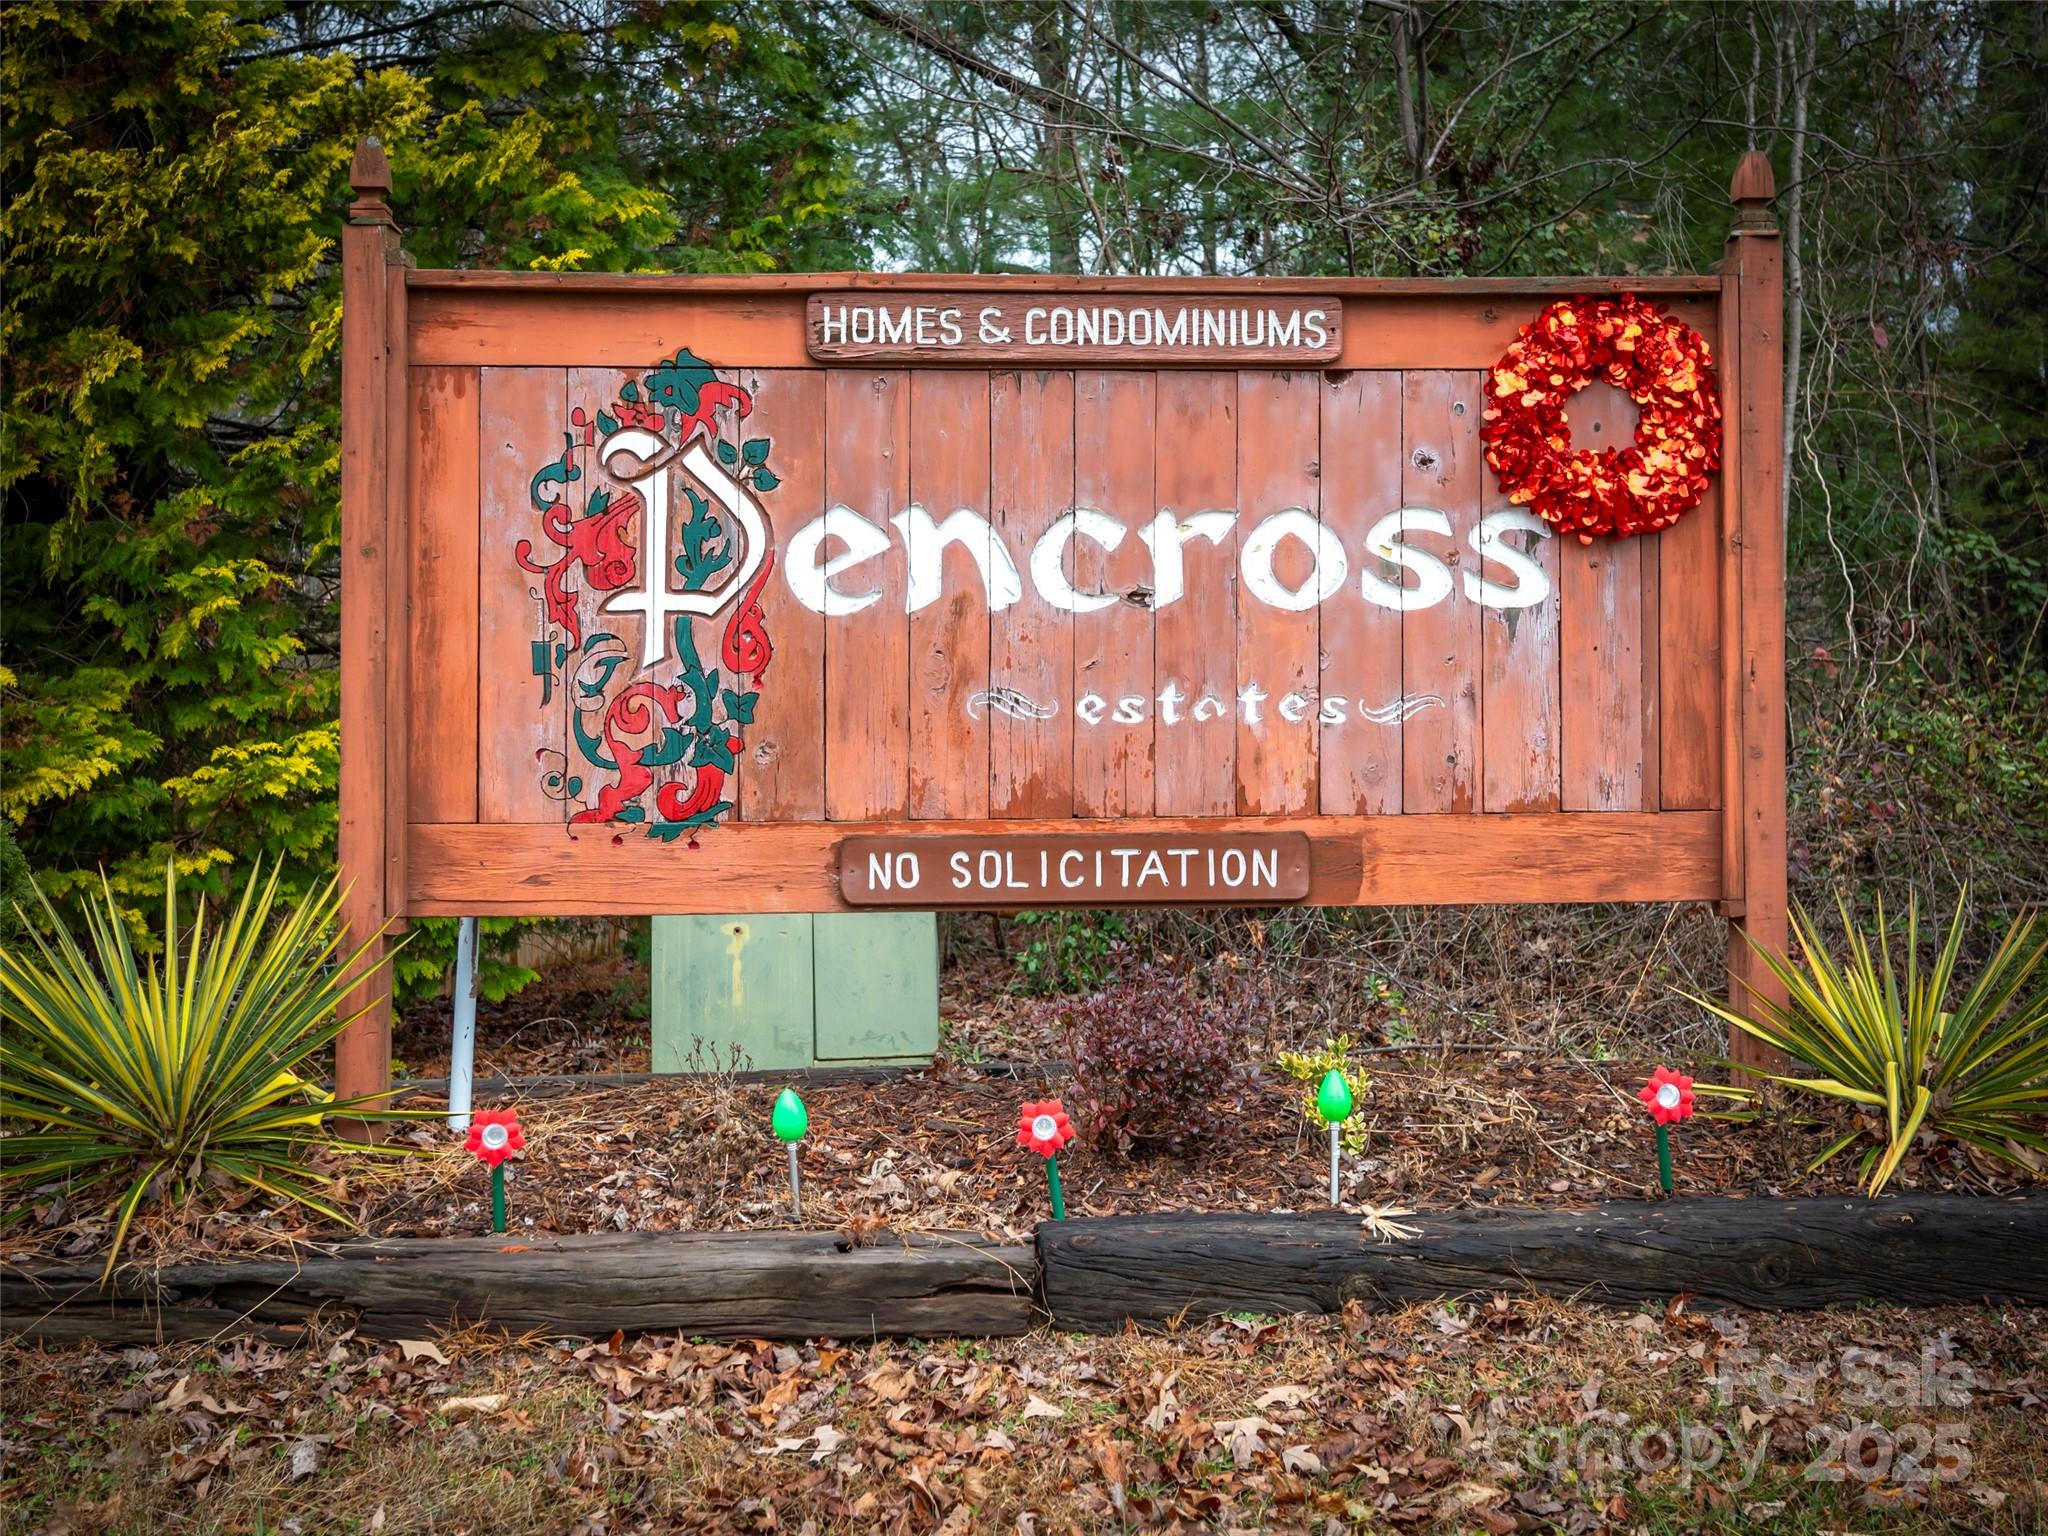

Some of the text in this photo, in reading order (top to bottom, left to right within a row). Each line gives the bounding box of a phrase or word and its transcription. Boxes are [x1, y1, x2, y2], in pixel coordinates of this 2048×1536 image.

[822, 305, 1330, 349] HOMES & CONDOMINIUMS
[600, 425, 1551, 668] Pencross
[1075, 681, 1348, 727] estates
[867, 848, 1279, 891] NO SOLICITATION
